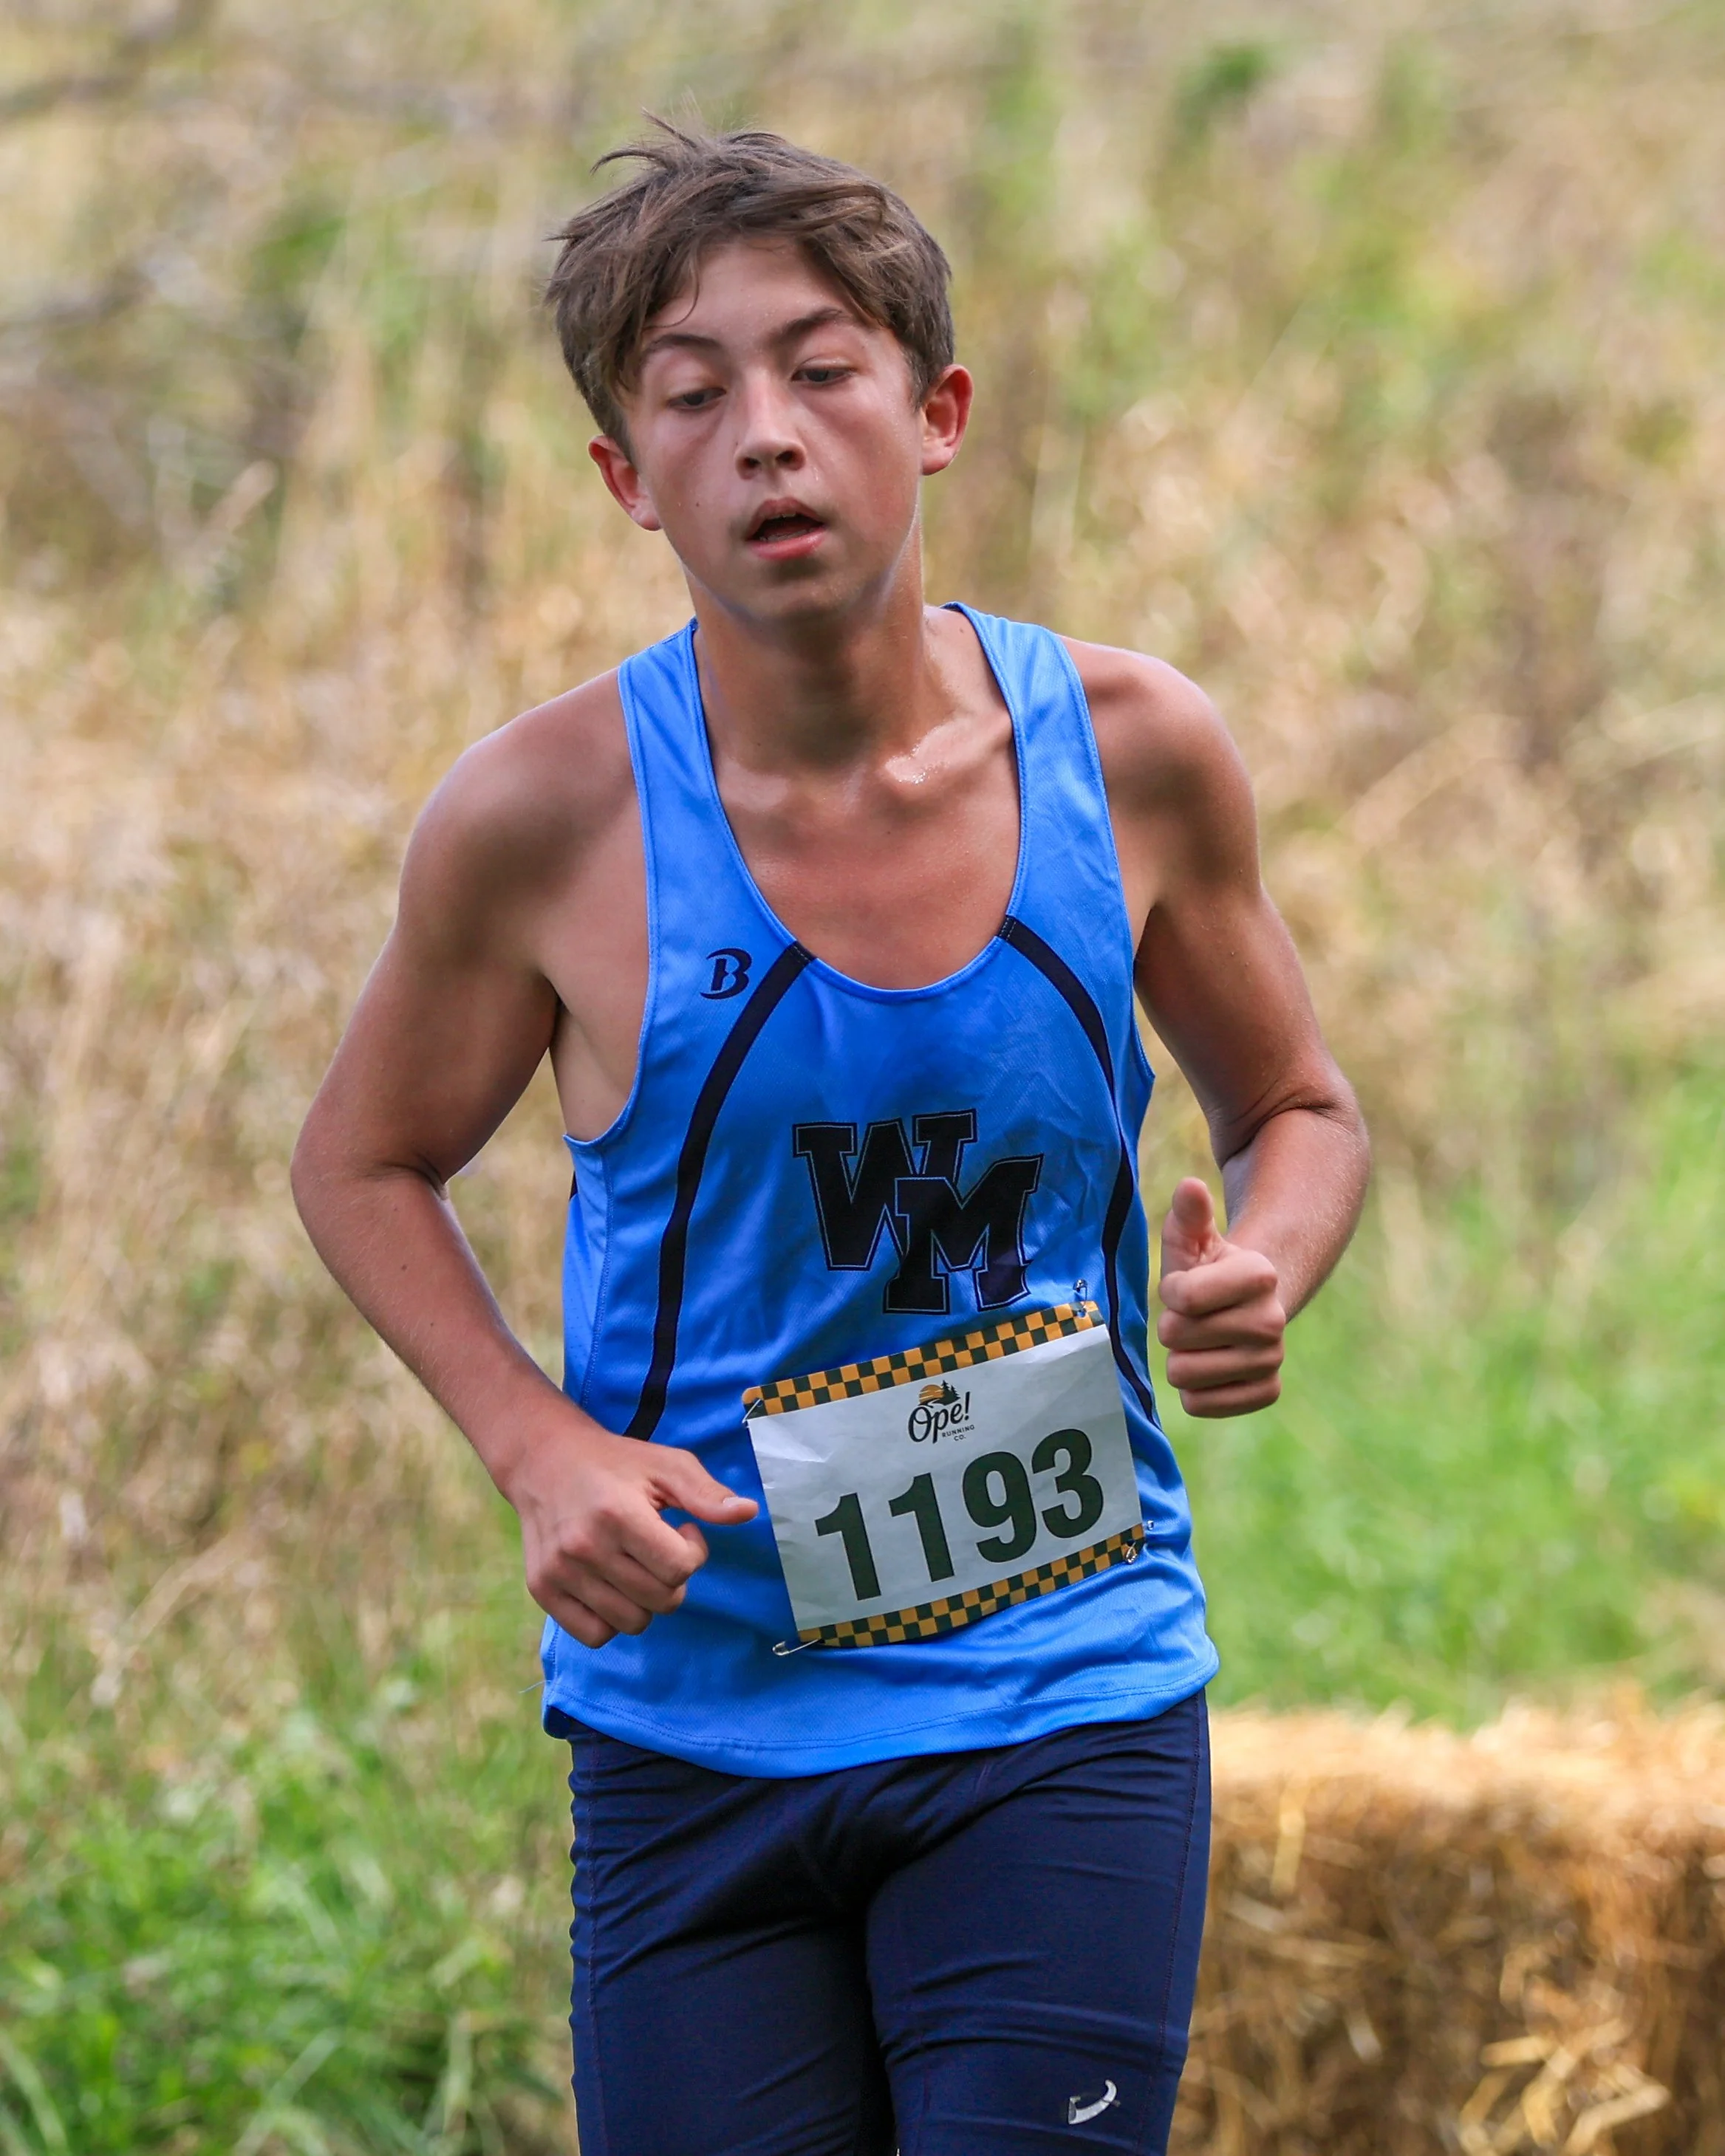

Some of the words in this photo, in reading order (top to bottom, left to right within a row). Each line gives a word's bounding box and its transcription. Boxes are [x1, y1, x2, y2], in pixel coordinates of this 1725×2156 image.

[700, 948, 753, 1000] B
[793, 1108, 1045, 1315] WM
[908, 1391, 971, 1444] Ope!
[941, 1424, 975, 1437] RUNNING
[814, 1428, 1104, 1601] 1193
